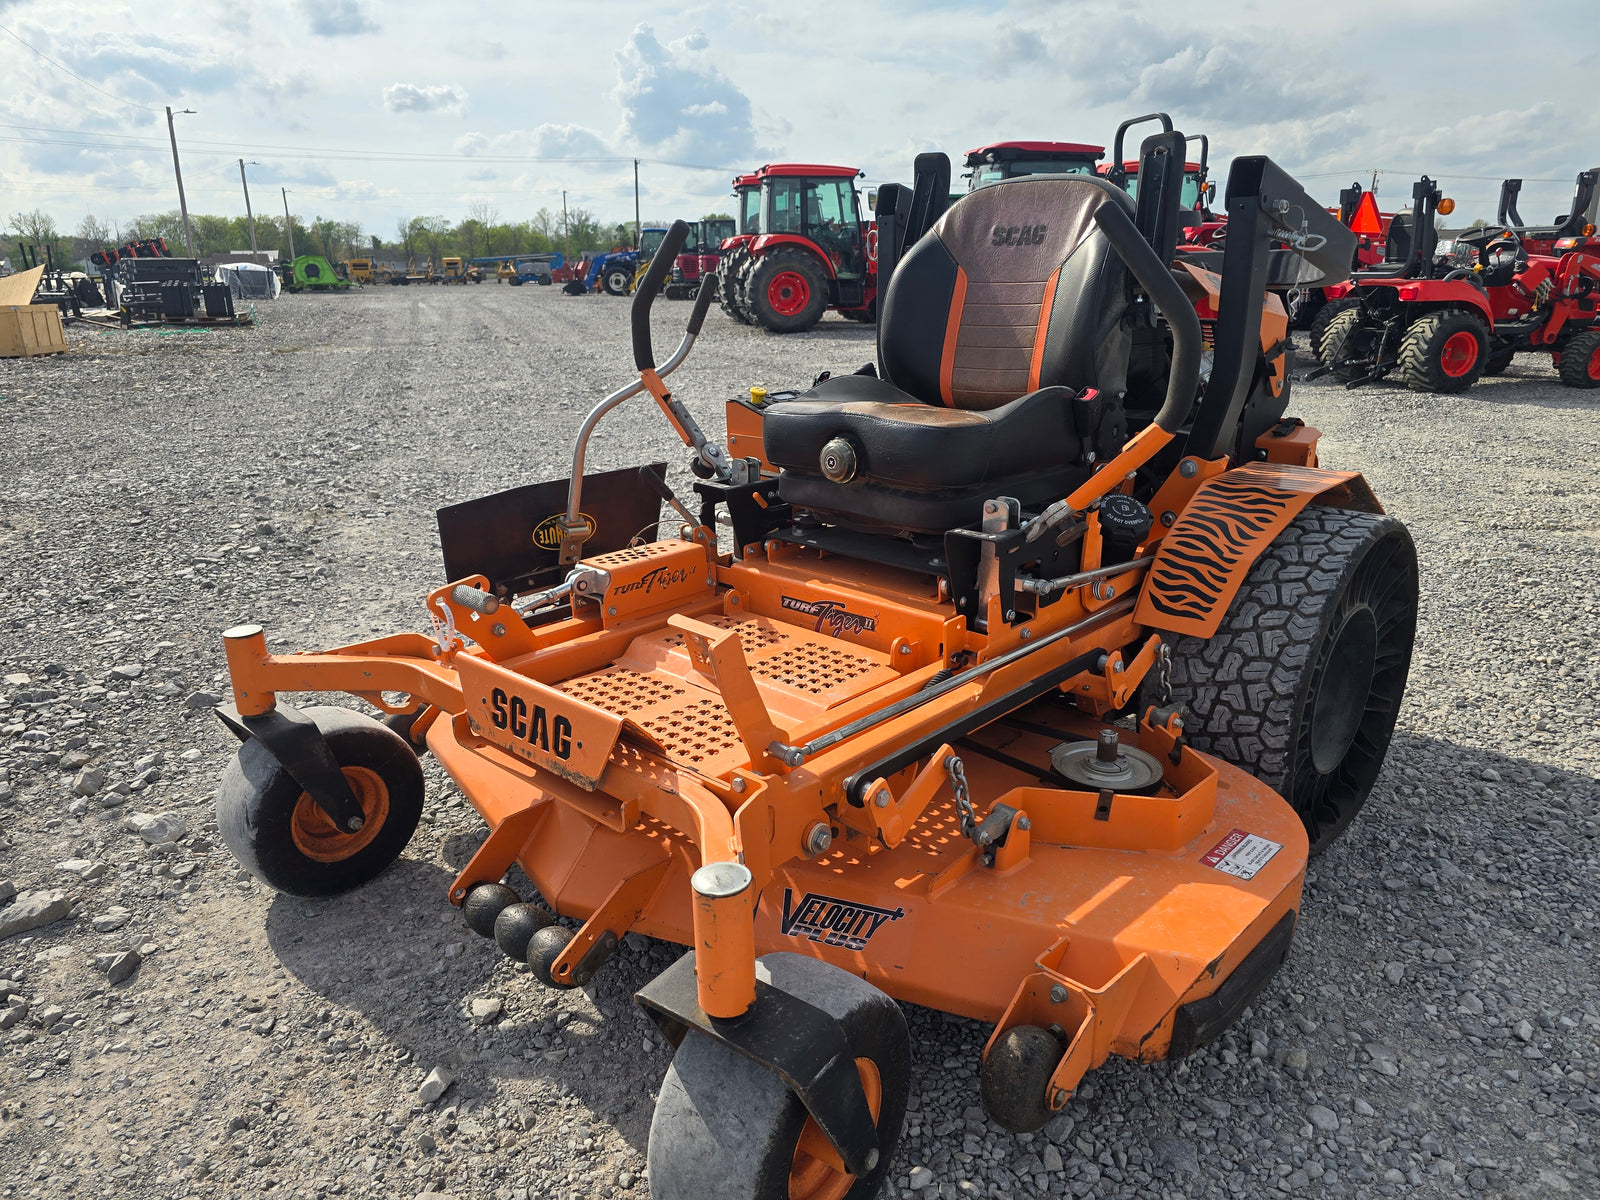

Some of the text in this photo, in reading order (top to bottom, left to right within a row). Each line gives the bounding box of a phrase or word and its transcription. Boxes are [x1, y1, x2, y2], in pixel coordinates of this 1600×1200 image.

[991, 225, 1047, 246] SCAG
[613, 578, 648, 596] TURF
[641, 566, 688, 594] Tiger
[782, 597, 874, 638] TURF Tiger II
[491, 687, 572, 761] SCAG
[1214, 832, 1245, 856] DANGER
[788, 924, 868, 951] PLUS
